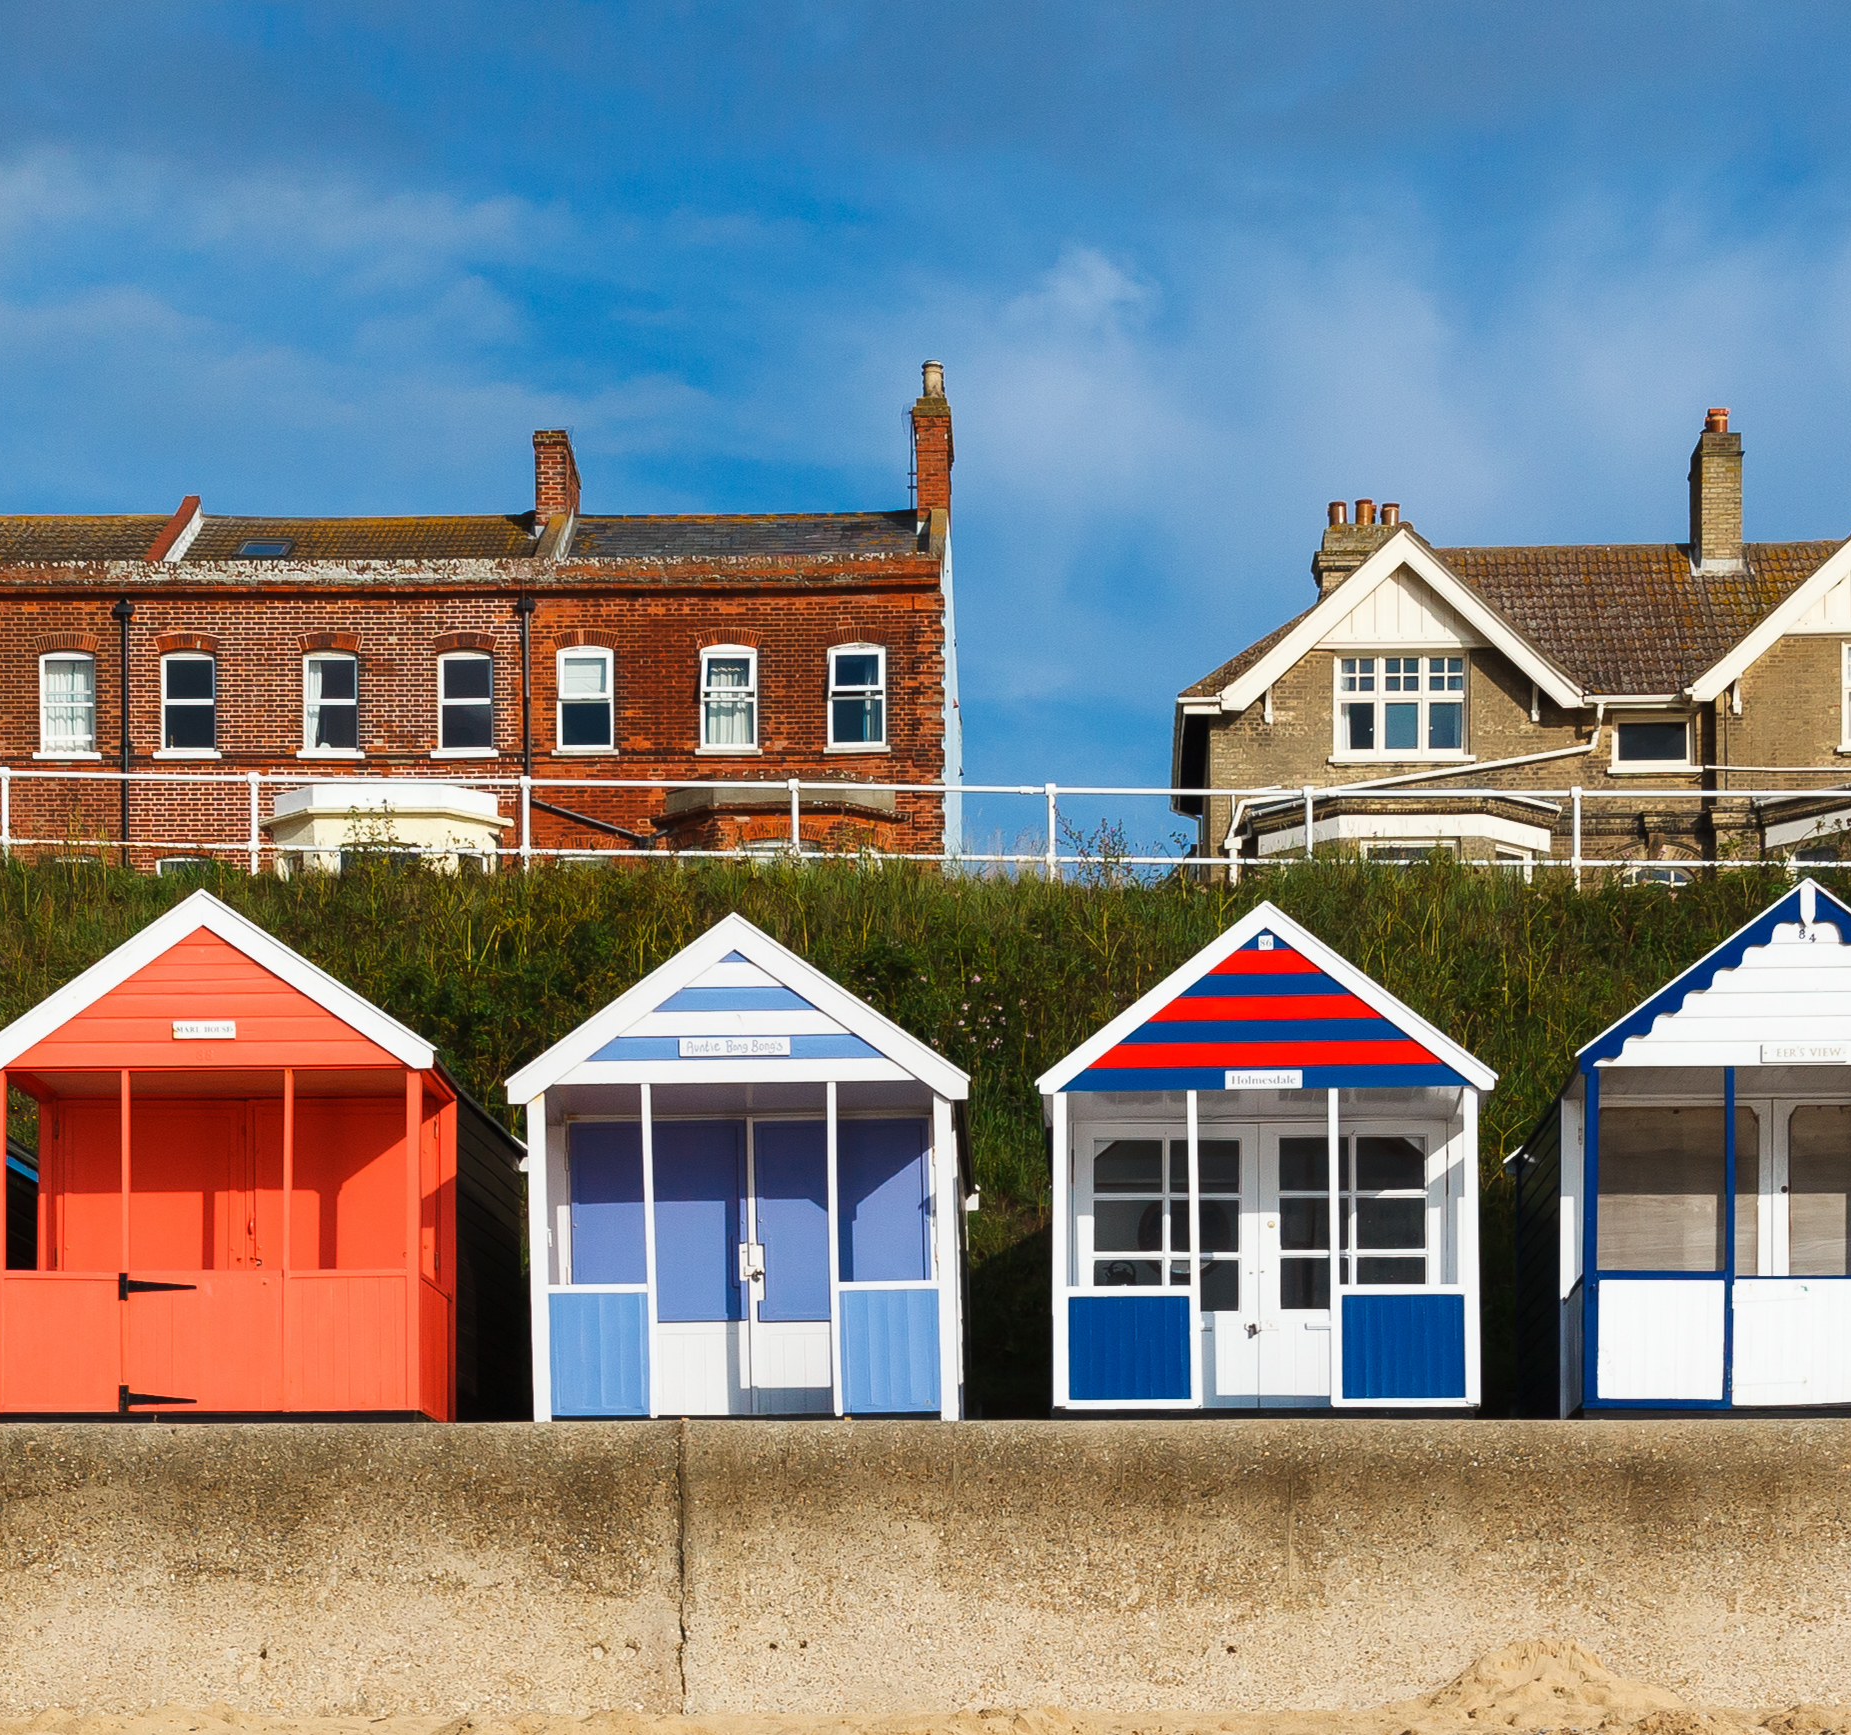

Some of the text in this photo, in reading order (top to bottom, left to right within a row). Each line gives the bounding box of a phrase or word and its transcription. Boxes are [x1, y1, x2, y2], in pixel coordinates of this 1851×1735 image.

[1259, 938, 1273, 948] 86
[204, 1026, 233, 1034] HOUSE
[686, 1039, 784, 1055] Auntie Bong Bong's
[1809, 1047, 1842, 1057] VIEW
[1231, 1075, 1297, 1085] Holmesdale
